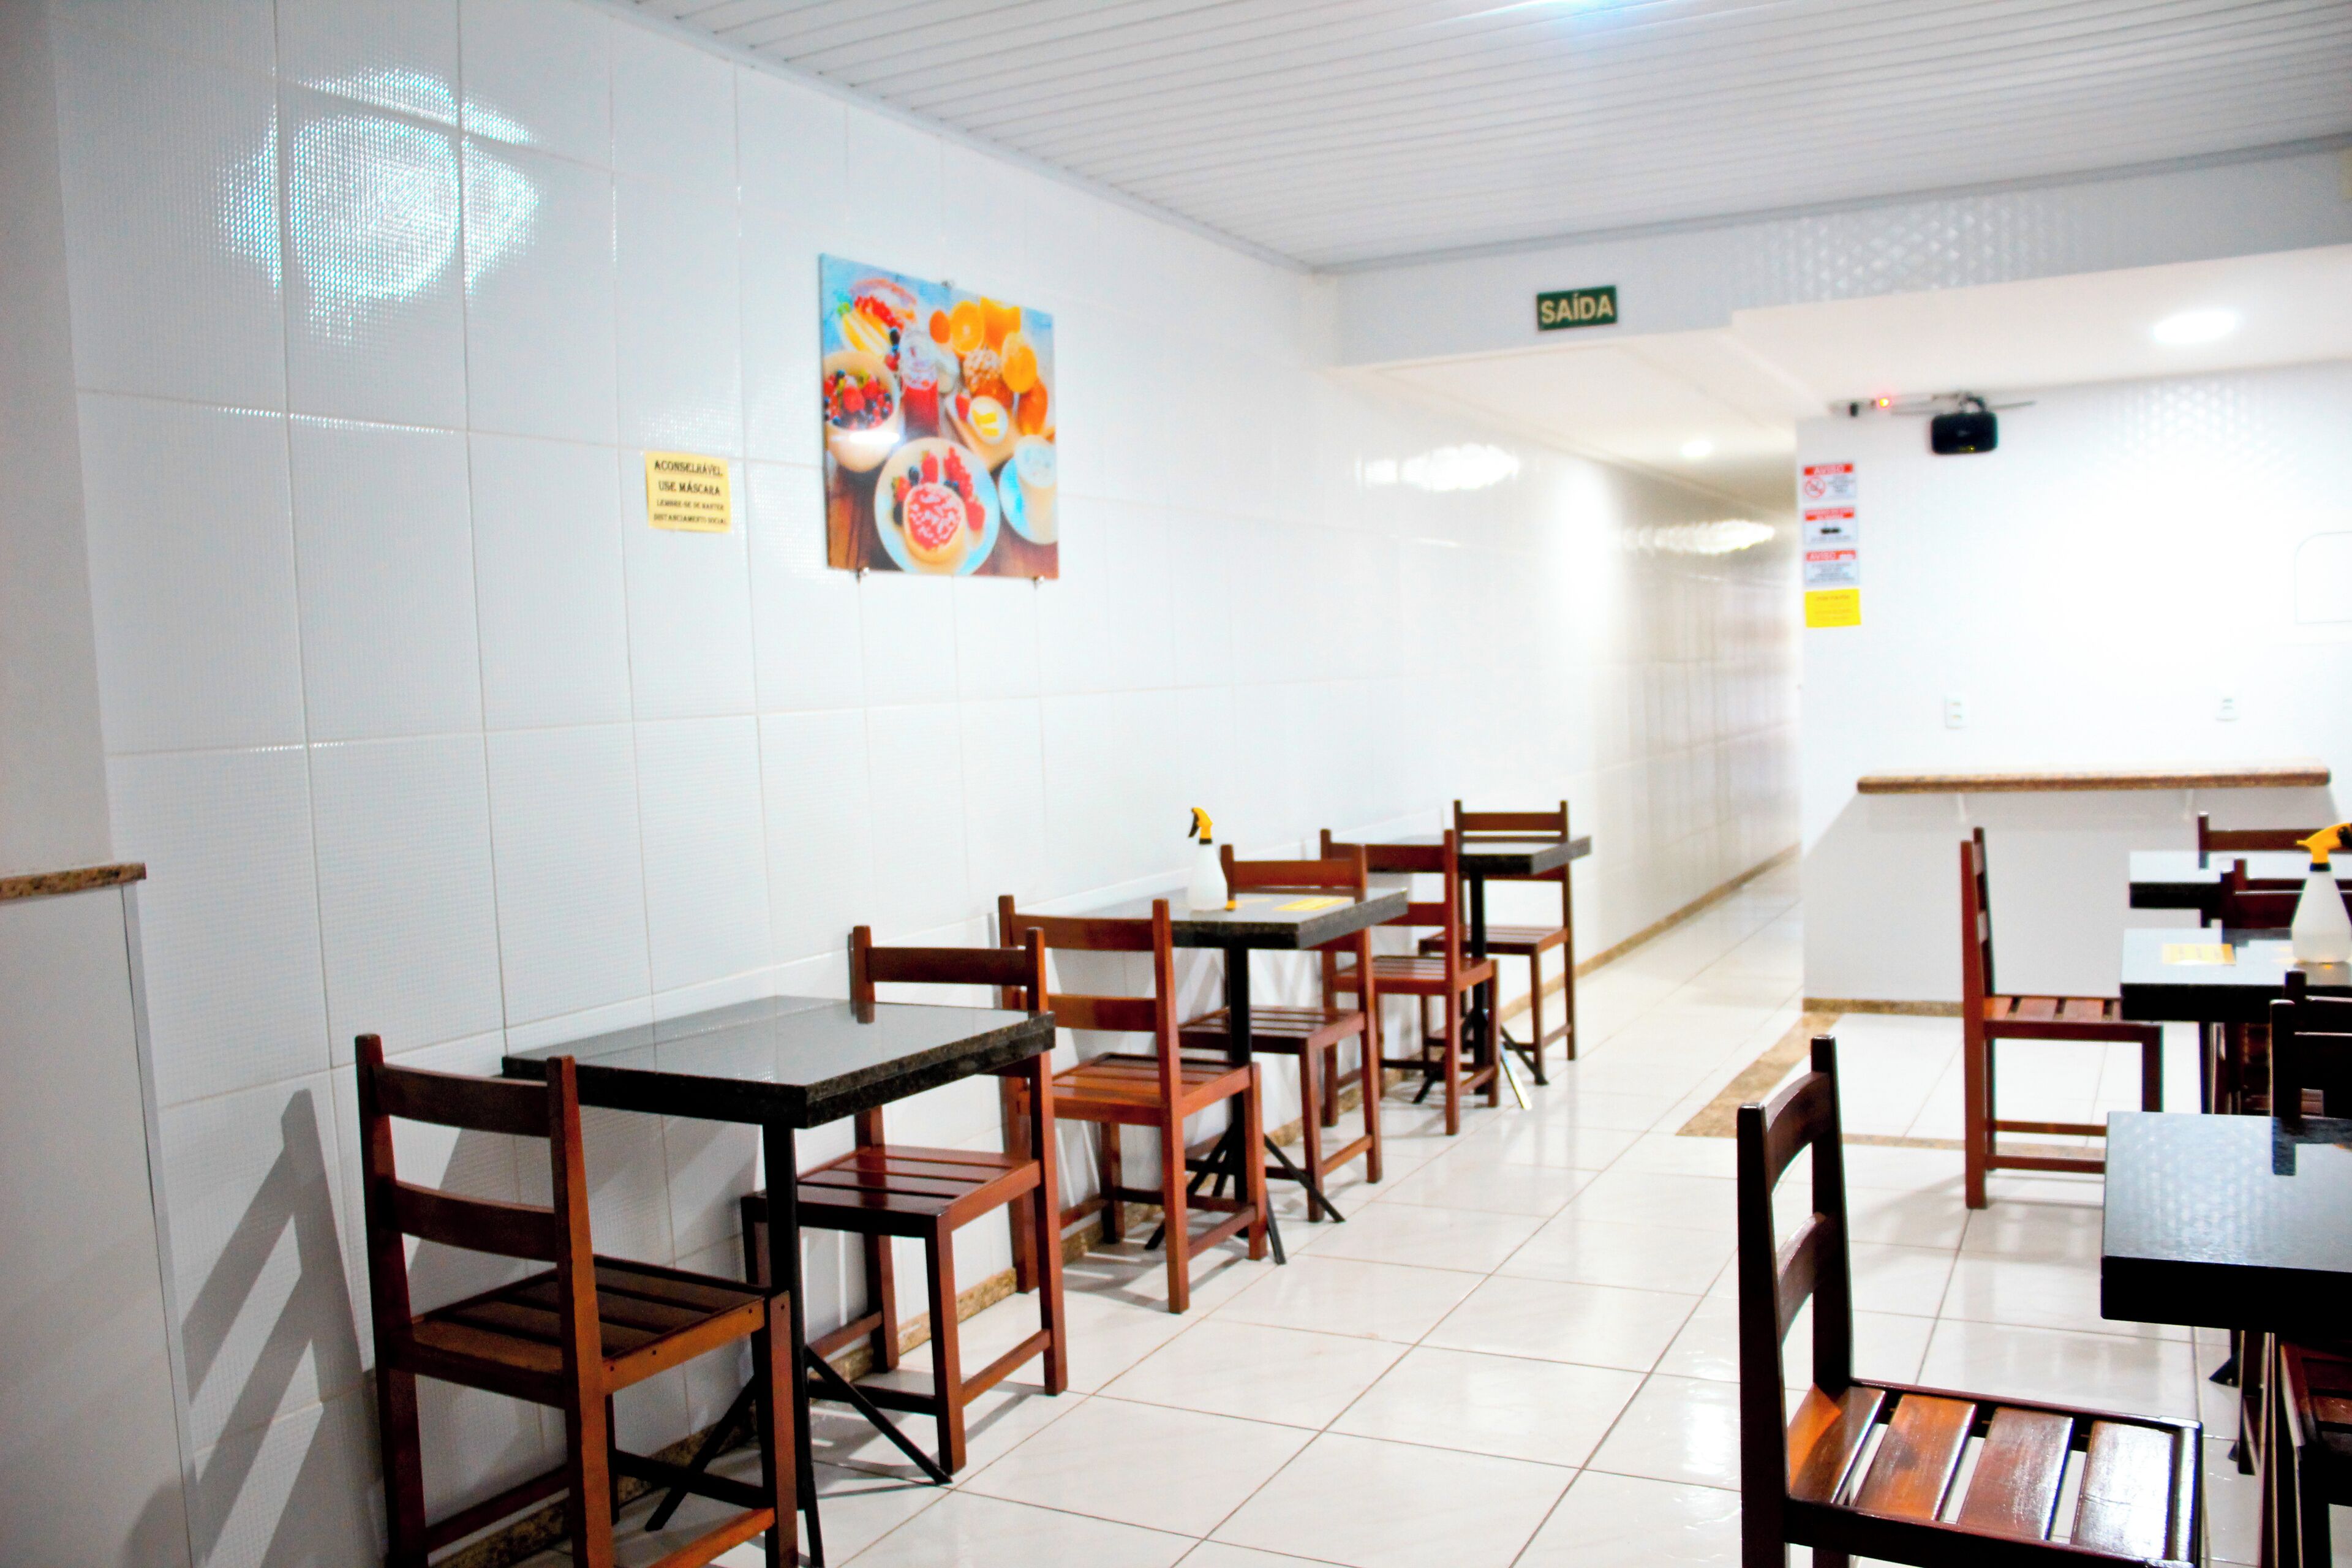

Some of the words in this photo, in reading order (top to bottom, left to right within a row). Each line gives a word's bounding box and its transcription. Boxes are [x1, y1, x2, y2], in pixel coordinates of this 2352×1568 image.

[1541, 293, 1613, 323] SAÍDA
[658, 481, 676, 492] USE
[679, 481, 720, 496] MÁSCARA
